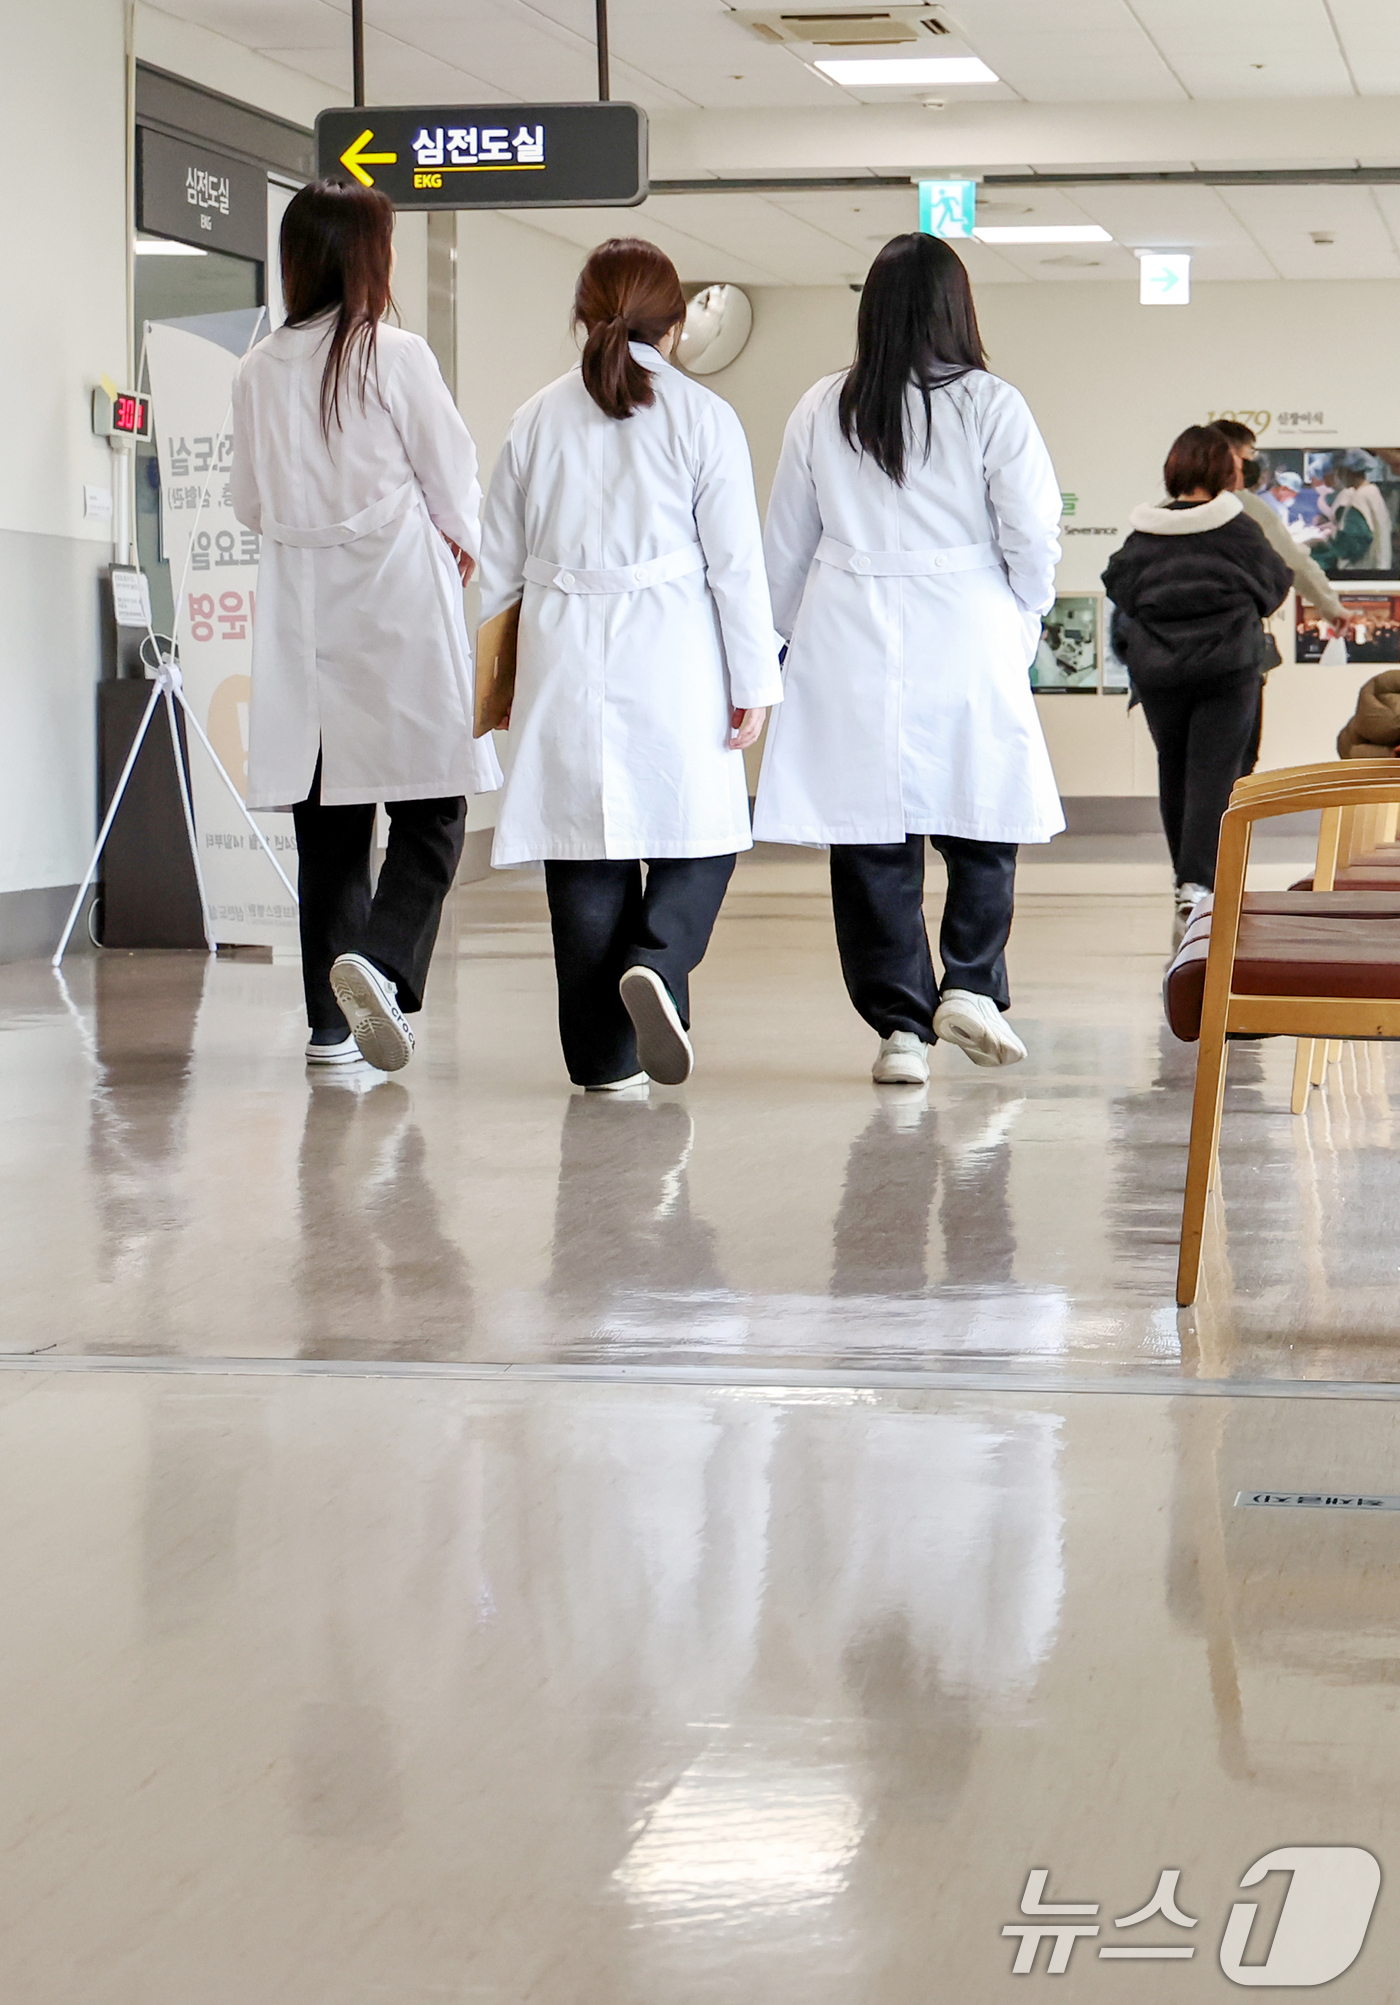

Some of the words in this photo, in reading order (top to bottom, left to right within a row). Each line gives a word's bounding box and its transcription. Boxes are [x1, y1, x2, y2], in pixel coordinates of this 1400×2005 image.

[412, 126, 546, 165] 심전도실
[186, 167, 229, 215] 심전도실
[413, 174, 443, 189] EKG
[1064, 524, 1118, 536] Severance
